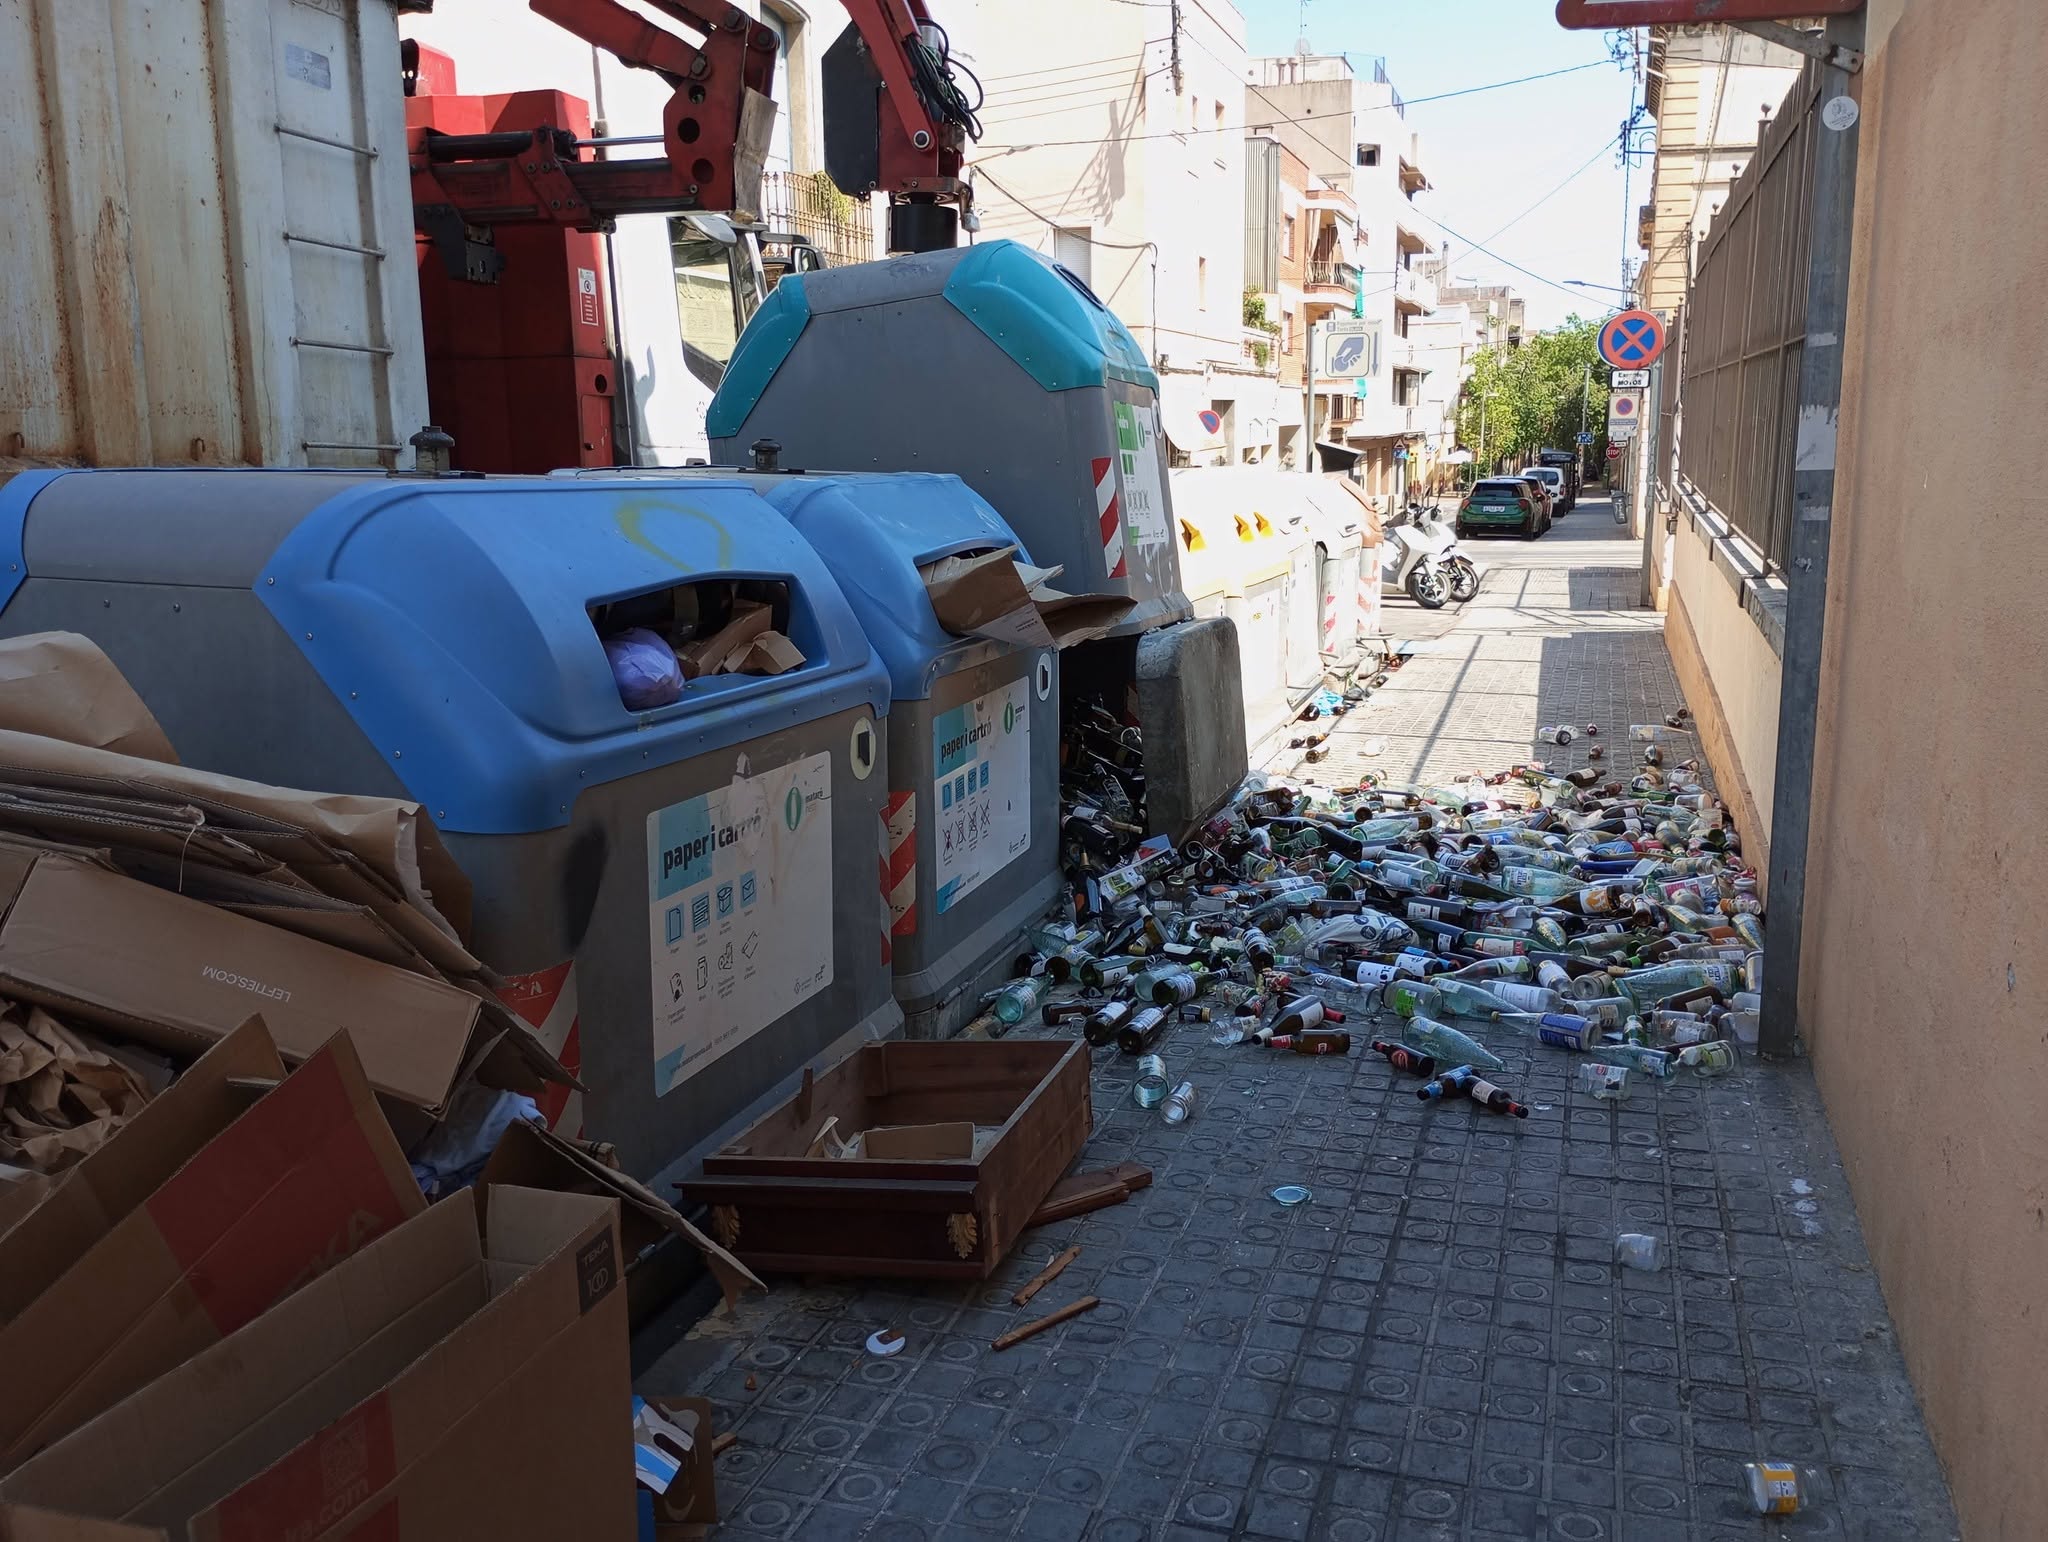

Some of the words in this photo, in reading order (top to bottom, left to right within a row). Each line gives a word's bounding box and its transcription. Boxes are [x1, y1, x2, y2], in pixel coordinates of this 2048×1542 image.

[940, 731, 964, 764] paper
[964, 727, 968, 747] i
[663, 834, 709, 880] paper
[711, 825, 716, 851] i
[202, 965, 292, 1003] LEFTIES.COM
[583, 1239, 609, 1268] TEKA
[588, 1267, 609, 1297] 100
